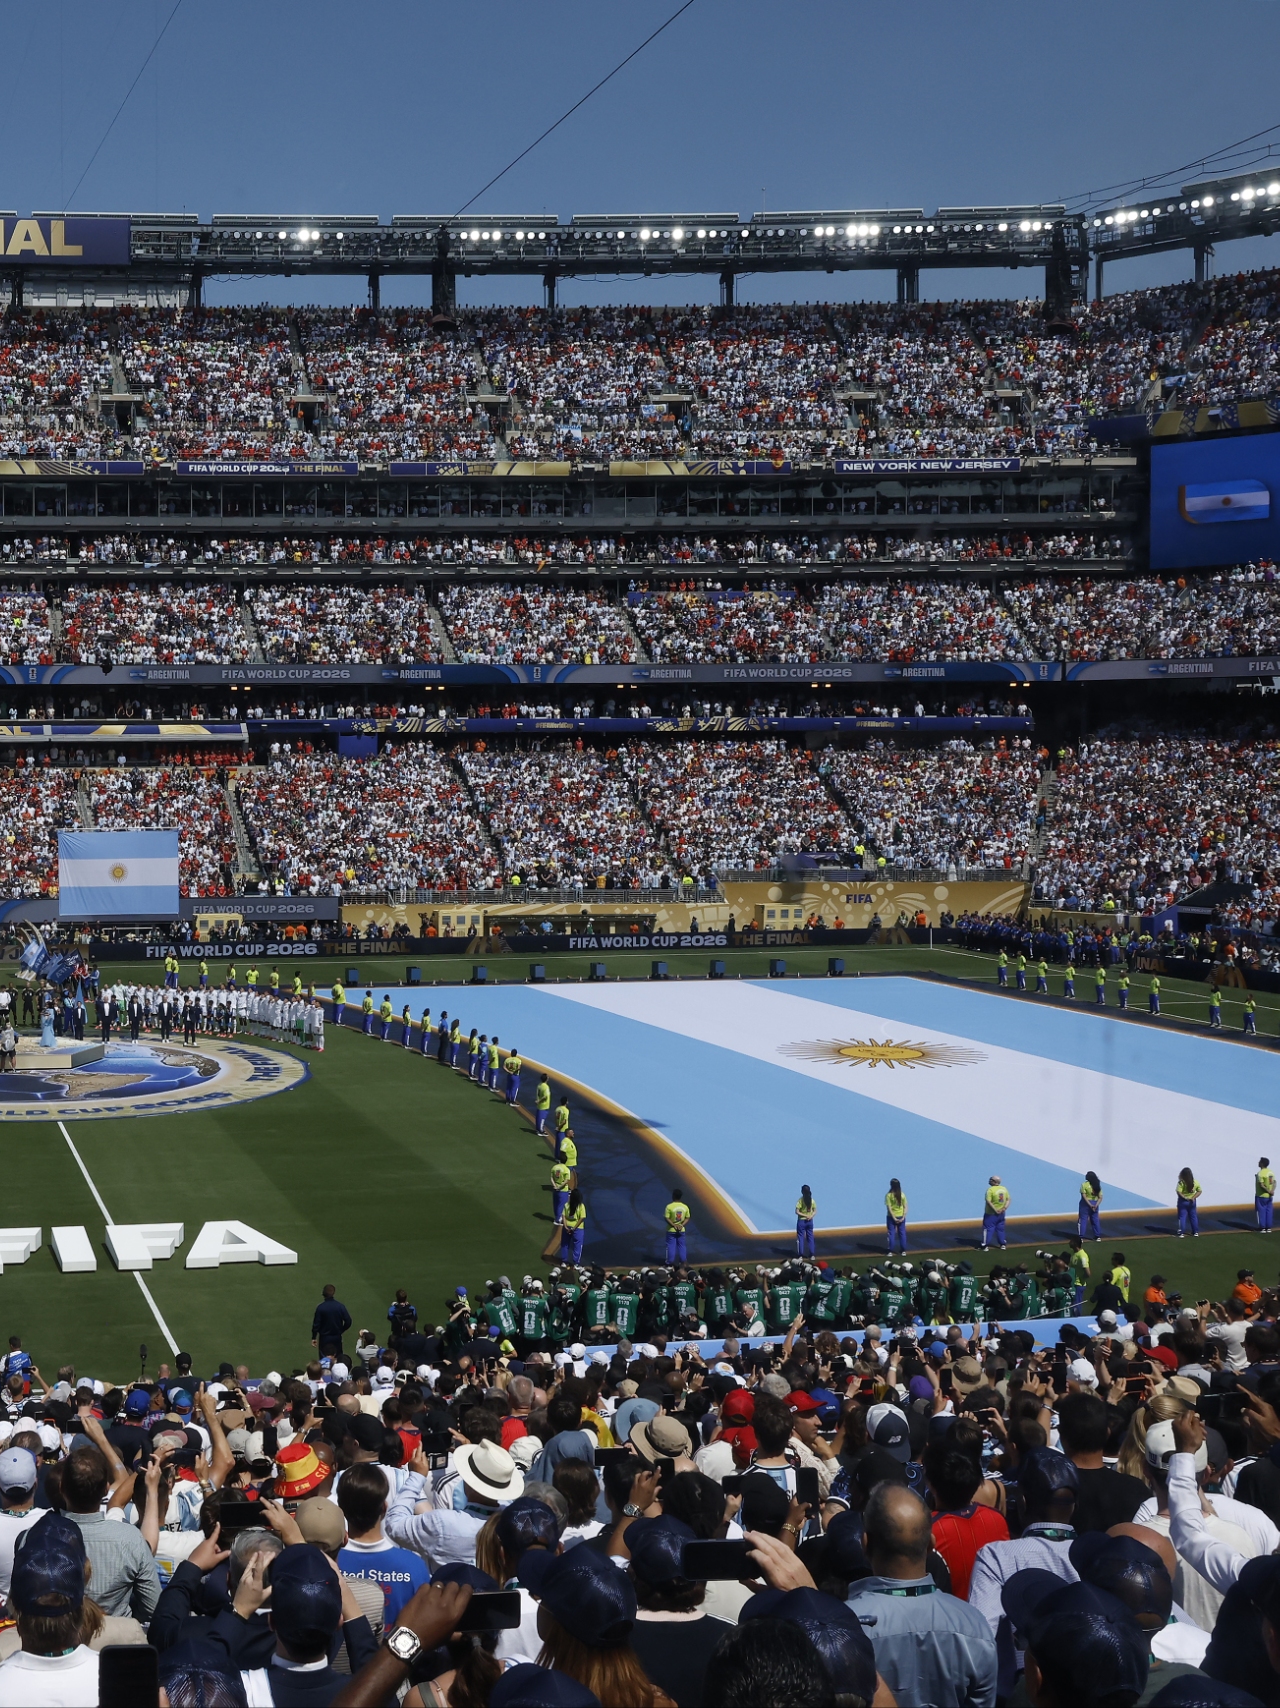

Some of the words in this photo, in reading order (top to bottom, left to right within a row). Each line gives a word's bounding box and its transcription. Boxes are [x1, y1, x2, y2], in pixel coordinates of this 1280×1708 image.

[189, 464, 207, 474] FIFA
[209, 464, 239, 474] WORLD
[241, 464, 258, 474] CUP
[260, 464, 289, 474] 2026
[293, 464, 314, 474] THE
[316, 464, 345, 474] FINAL
[843, 462, 875, 473] NEW
[878, 462, 917, 473] YORK
[920, 461, 953, 472] NEW
[955, 461, 1011, 472] JERSEY
[902, 667, 946, 678] ARGENTINA
[1167, 663, 1214, 674] ARGENTINA
[1249, 661, 1274, 672] FIFA
[148, 670, 190, 680] ARGENTINA
[221, 669, 244, 680] FIFA
[245, 669, 287, 680] WORLD
[288, 669, 311, 680] CUP
[312, 669, 351, 680] 2026
[399, 669, 442, 680] ARGENTINA
[650, 668, 692, 679] ARGENTINA
[723, 668, 747, 679] FIFA
[748, 668, 789, 679] WORLD
[790, 667, 812, 678] CUP
[813, 667, 853, 678] 2026
[846, 894, 873, 904] FIFA
[193, 904, 215, 915] FIFA
[216, 904, 254, 914] WORLD
[255, 904, 277, 914] CUP
[278, 903, 315, 914] 2026
[569, 936, 599, 949] FIFA
[601, 935, 649, 948] WORLD
[651, 935, 678, 947] CUP
[680, 934, 728, 947] 2026
[732, 933, 763, 946] THE
[766, 932, 813, 945] FINAL
[146, 946, 177, 959] FIFA
[179, 945, 233, 958] WORLD
[236, 944, 264, 957] CUP
[266, 943, 318, 957] 2026
[322, 941, 357, 955] THE
[359, 941, 410, 954] FINAL
[1137, 957, 1168, 973] INAL
[57, 1105, 125, 1115] CUP
[129, 1091, 233, 1111] 2026
[315, 1462, 331, 1480] SPA
[339, 1569, 365, 1581] ited
[368, 1569, 411, 1582] States
